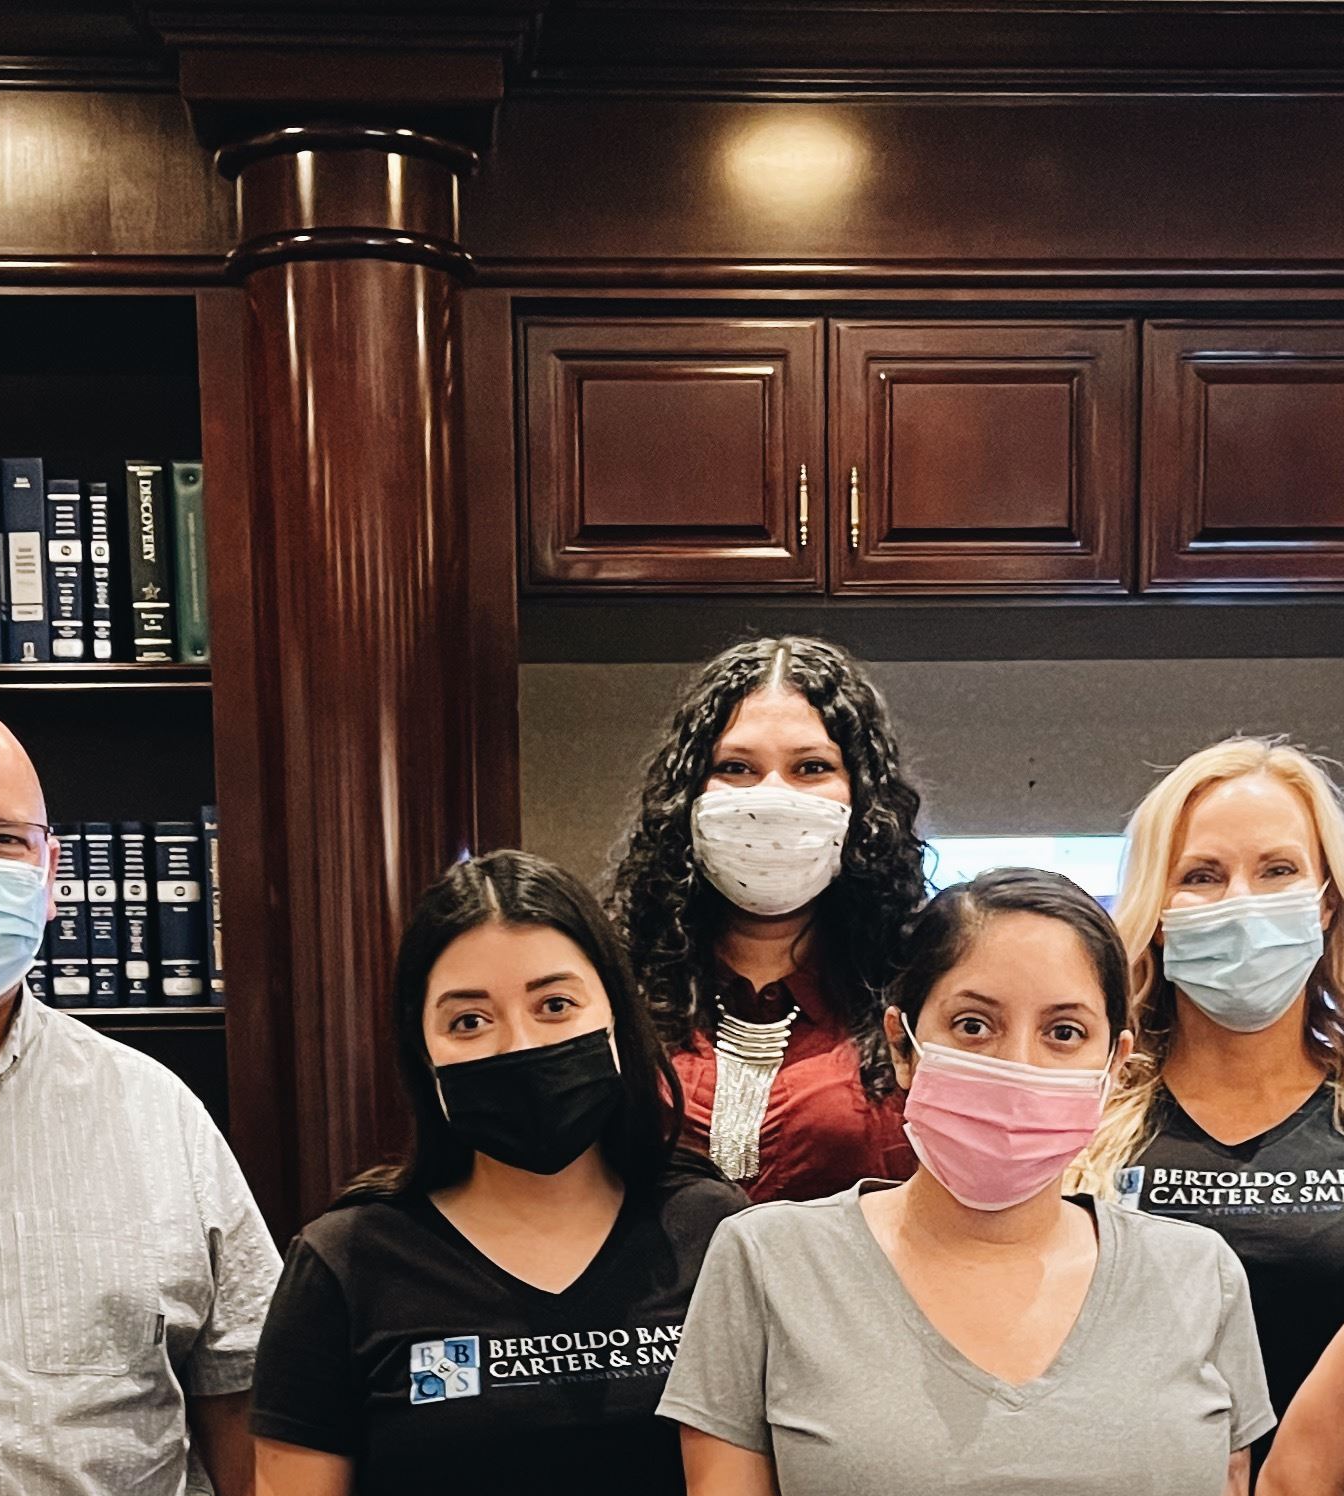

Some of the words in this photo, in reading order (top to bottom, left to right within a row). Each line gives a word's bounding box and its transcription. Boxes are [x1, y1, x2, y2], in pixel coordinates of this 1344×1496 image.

[139, 480, 155, 562] DISCOVERY
[1153, 1168, 1297, 1188] BERTOLDO
[1149, 1187, 1264, 1205] CARTER
[1271, 1187, 1293, 1204] &
[489, 1328, 630, 1359] BERTOLDO
[489, 1353, 604, 1378] CARTER
[609, 1349, 630, 1367] &
